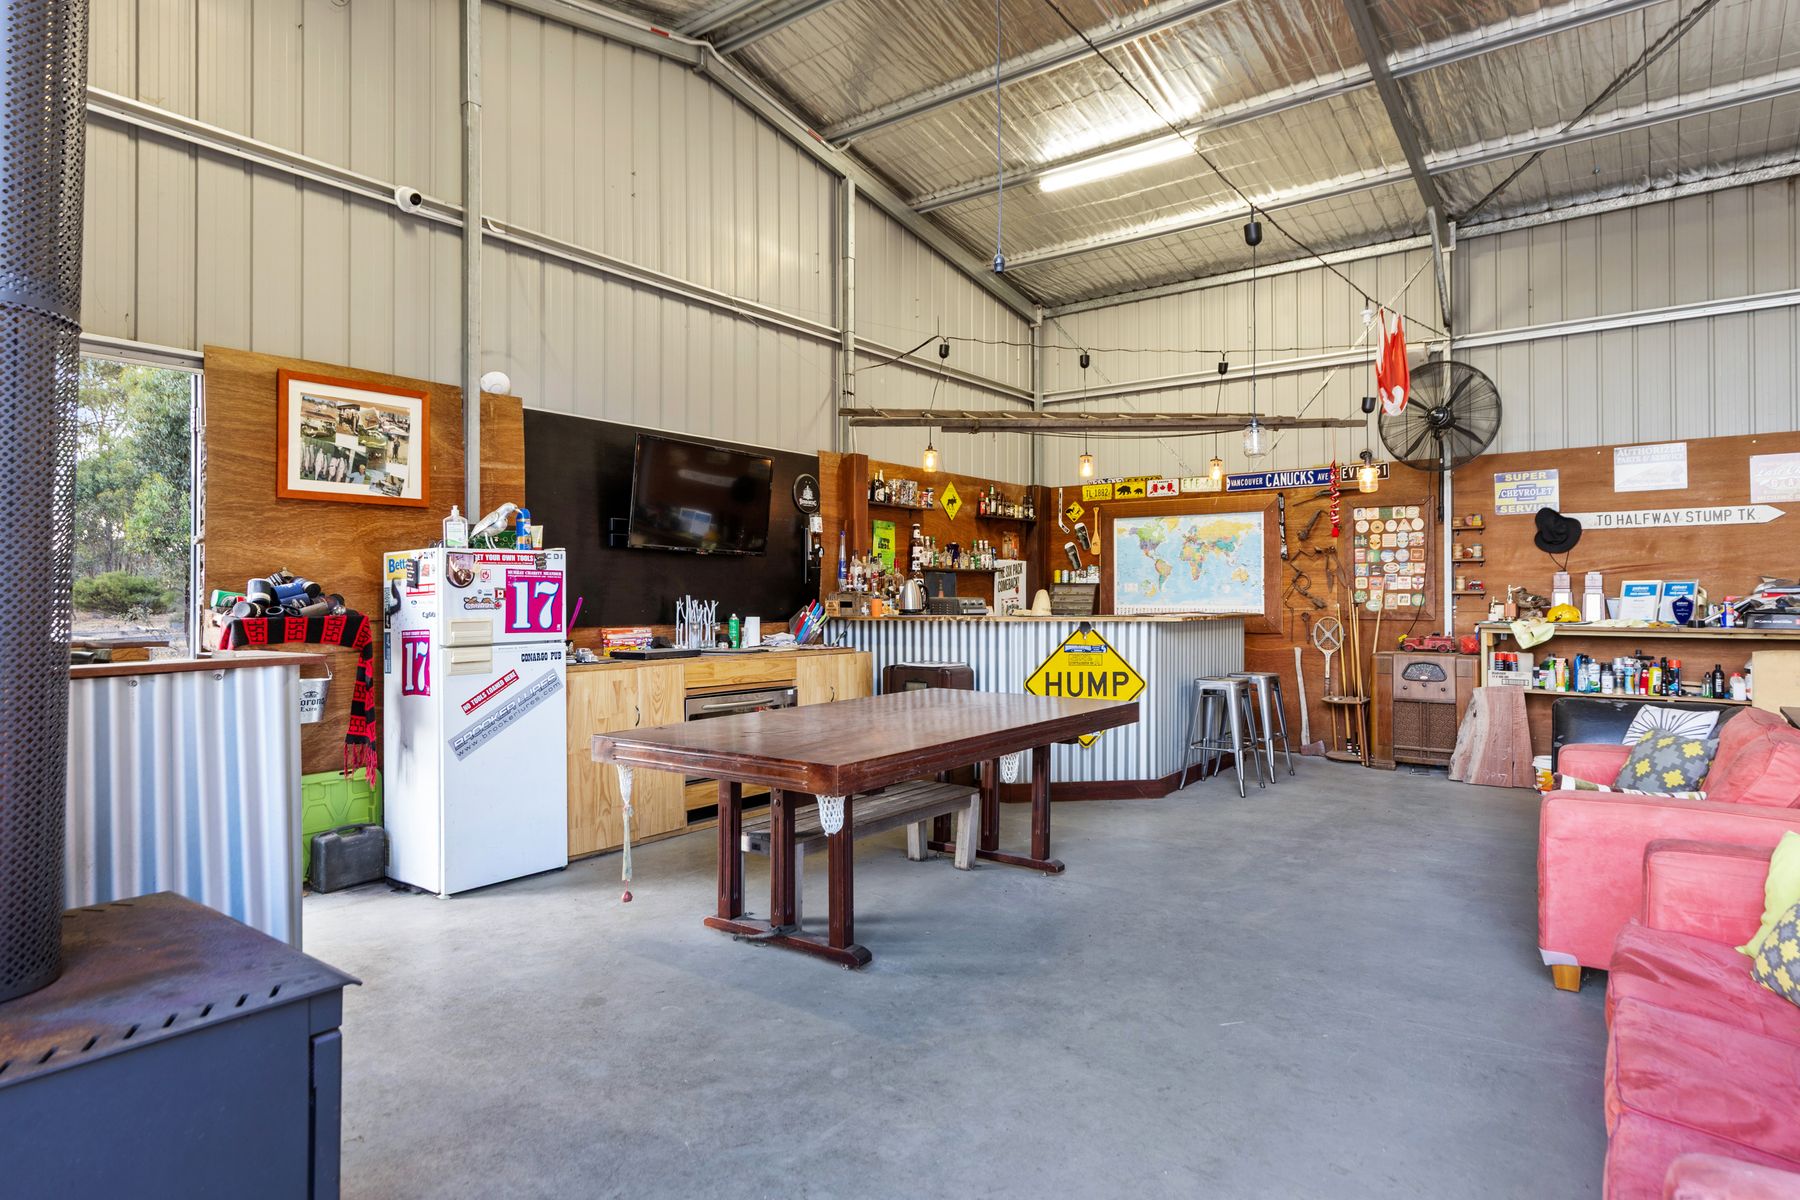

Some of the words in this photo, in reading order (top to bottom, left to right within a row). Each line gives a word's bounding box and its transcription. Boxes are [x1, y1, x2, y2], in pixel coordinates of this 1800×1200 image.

[1231, 477, 1263, 487] VANCOUVER
[1265, 470, 1315, 488] CANUCKS
[1317, 473, 1329, 481] AVE
[1505, 471, 1547, 481] SUPER
[1501, 487, 1553, 498] CHEVROLET
[1597, 514, 1612, 526] TO
[1616, 511, 1681, 526] HALFWAY
[1685, 509, 1733, 523] STUMP
[1738, 508, 1756, 520] TK
[512, 580, 560, 630] 17
[520, 652, 549, 662] CONARGO
[550, 651, 562, 660] PUB
[404, 640, 429, 692] 17
[1045, 671, 1130, 697] HUMP
[471, 692, 489, 707] TOOLS
[454, 701, 517, 751] BROOKER
[517, 673, 558, 708] LURES
[457, 681, 561, 757] www.brookerlures.com
